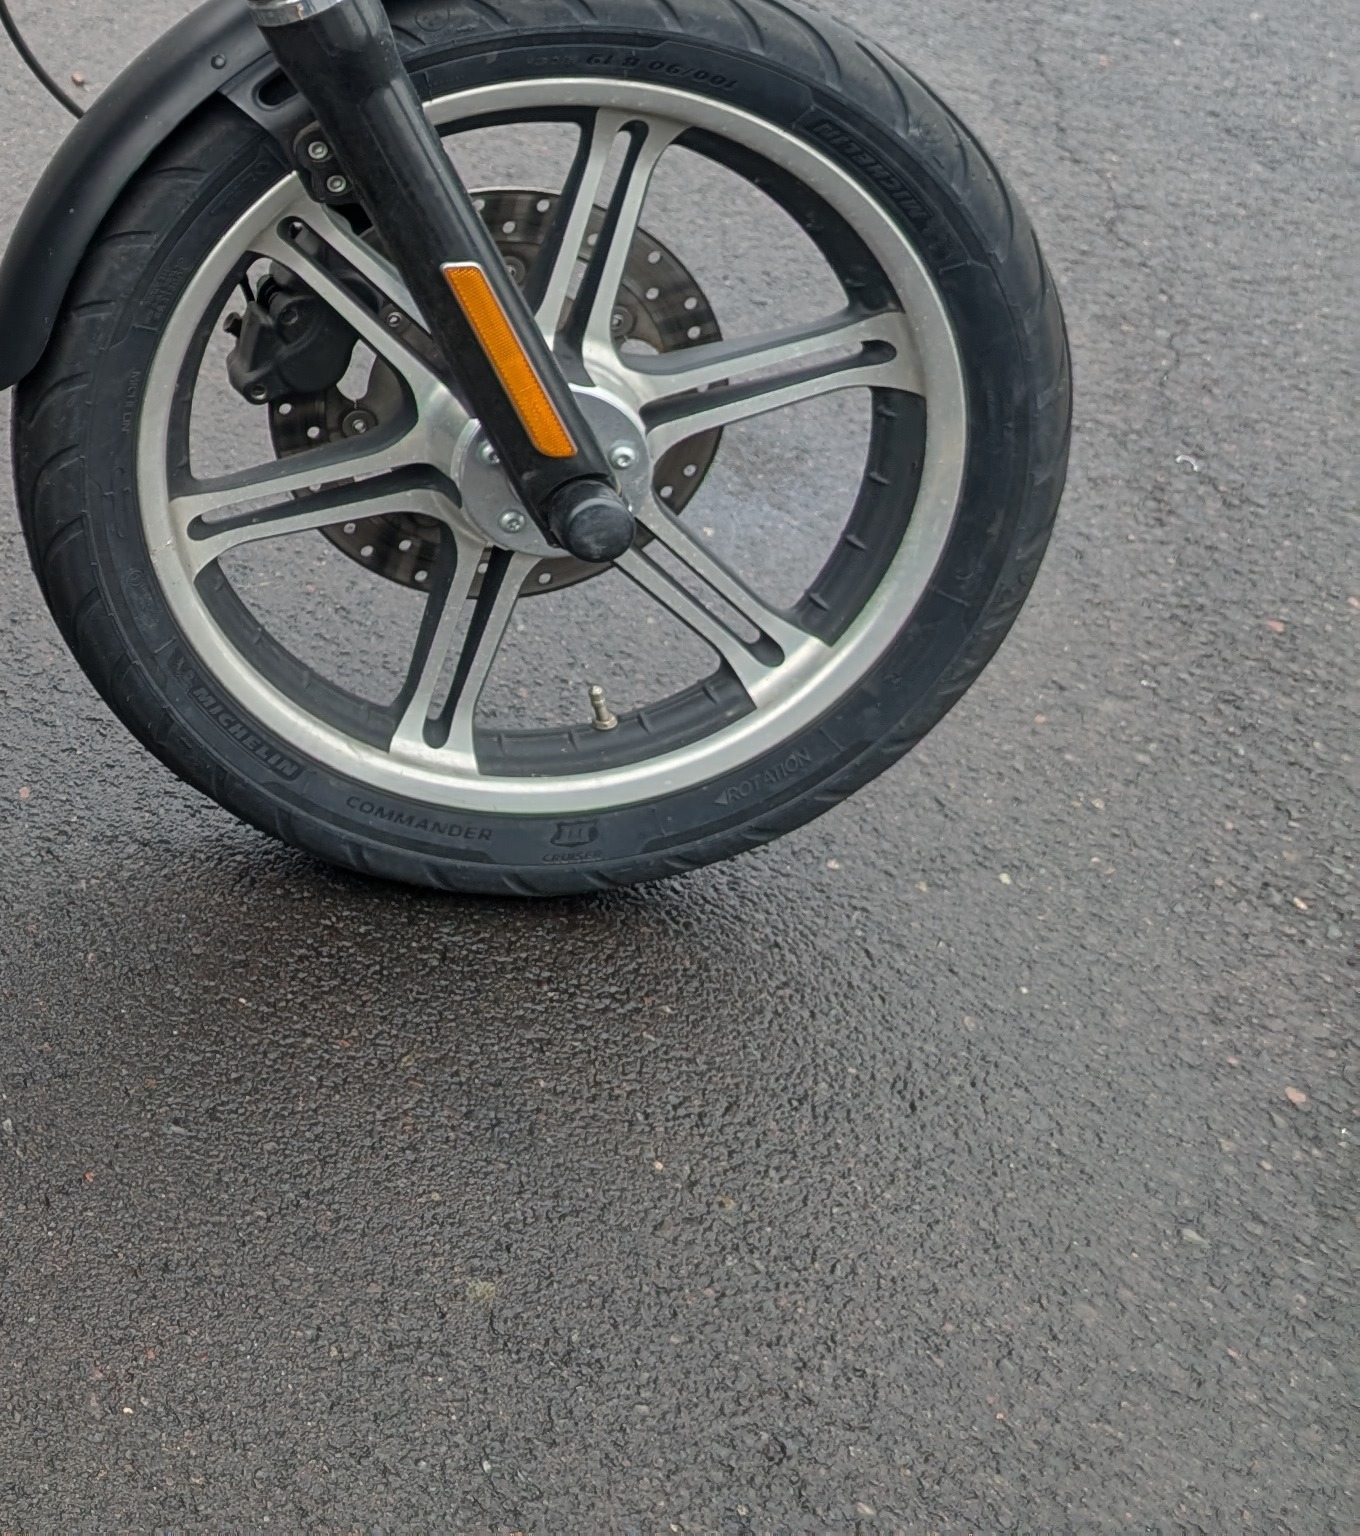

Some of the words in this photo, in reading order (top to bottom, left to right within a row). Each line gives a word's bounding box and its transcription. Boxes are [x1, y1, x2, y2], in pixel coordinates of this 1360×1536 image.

[193, 686, 299, 777] MICHELIN
[727, 747, 813, 801] ROTATION
[346, 795, 492, 842] COMMANDER
